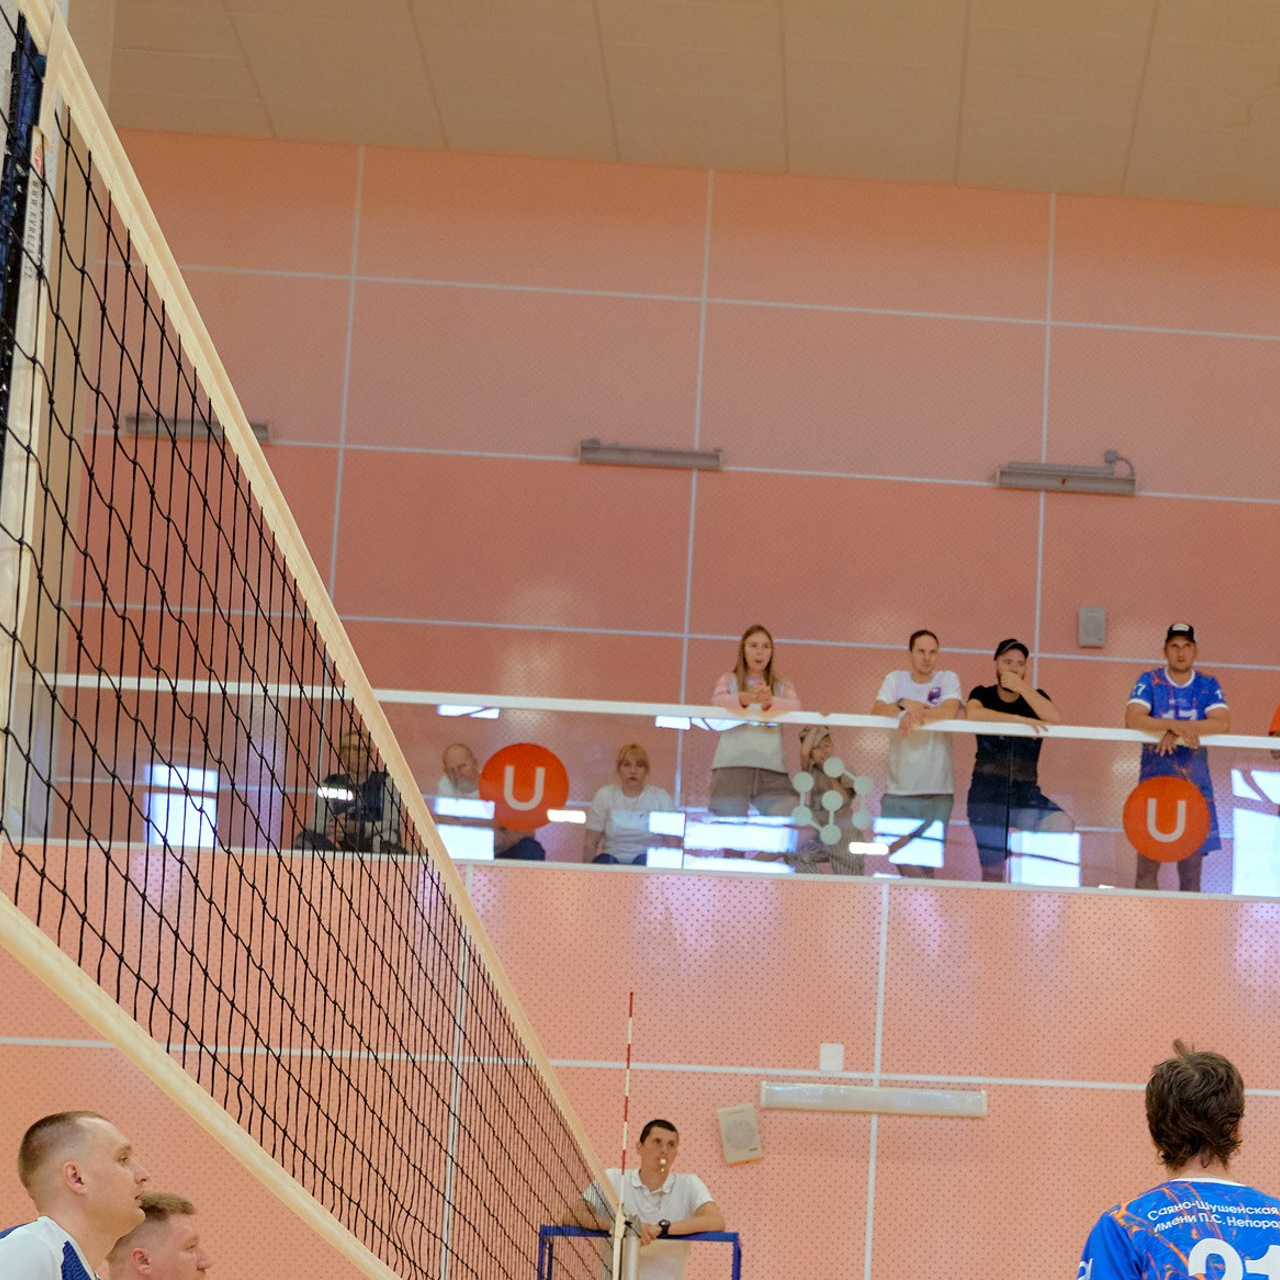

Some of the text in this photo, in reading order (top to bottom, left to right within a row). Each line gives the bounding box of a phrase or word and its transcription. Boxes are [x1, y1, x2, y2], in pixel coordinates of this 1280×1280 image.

[24, 180, 40, 279] WWW.KVREZA.CZ
[504, 764, 546, 811] U
[1147, 797, 1187, 843] U
[1147, 1200, 1278, 1221] Саяно-Шушенская
[1154, 1215, 1197, 1233] имени
[1198, 1212, 1226, 1225] П.С.
